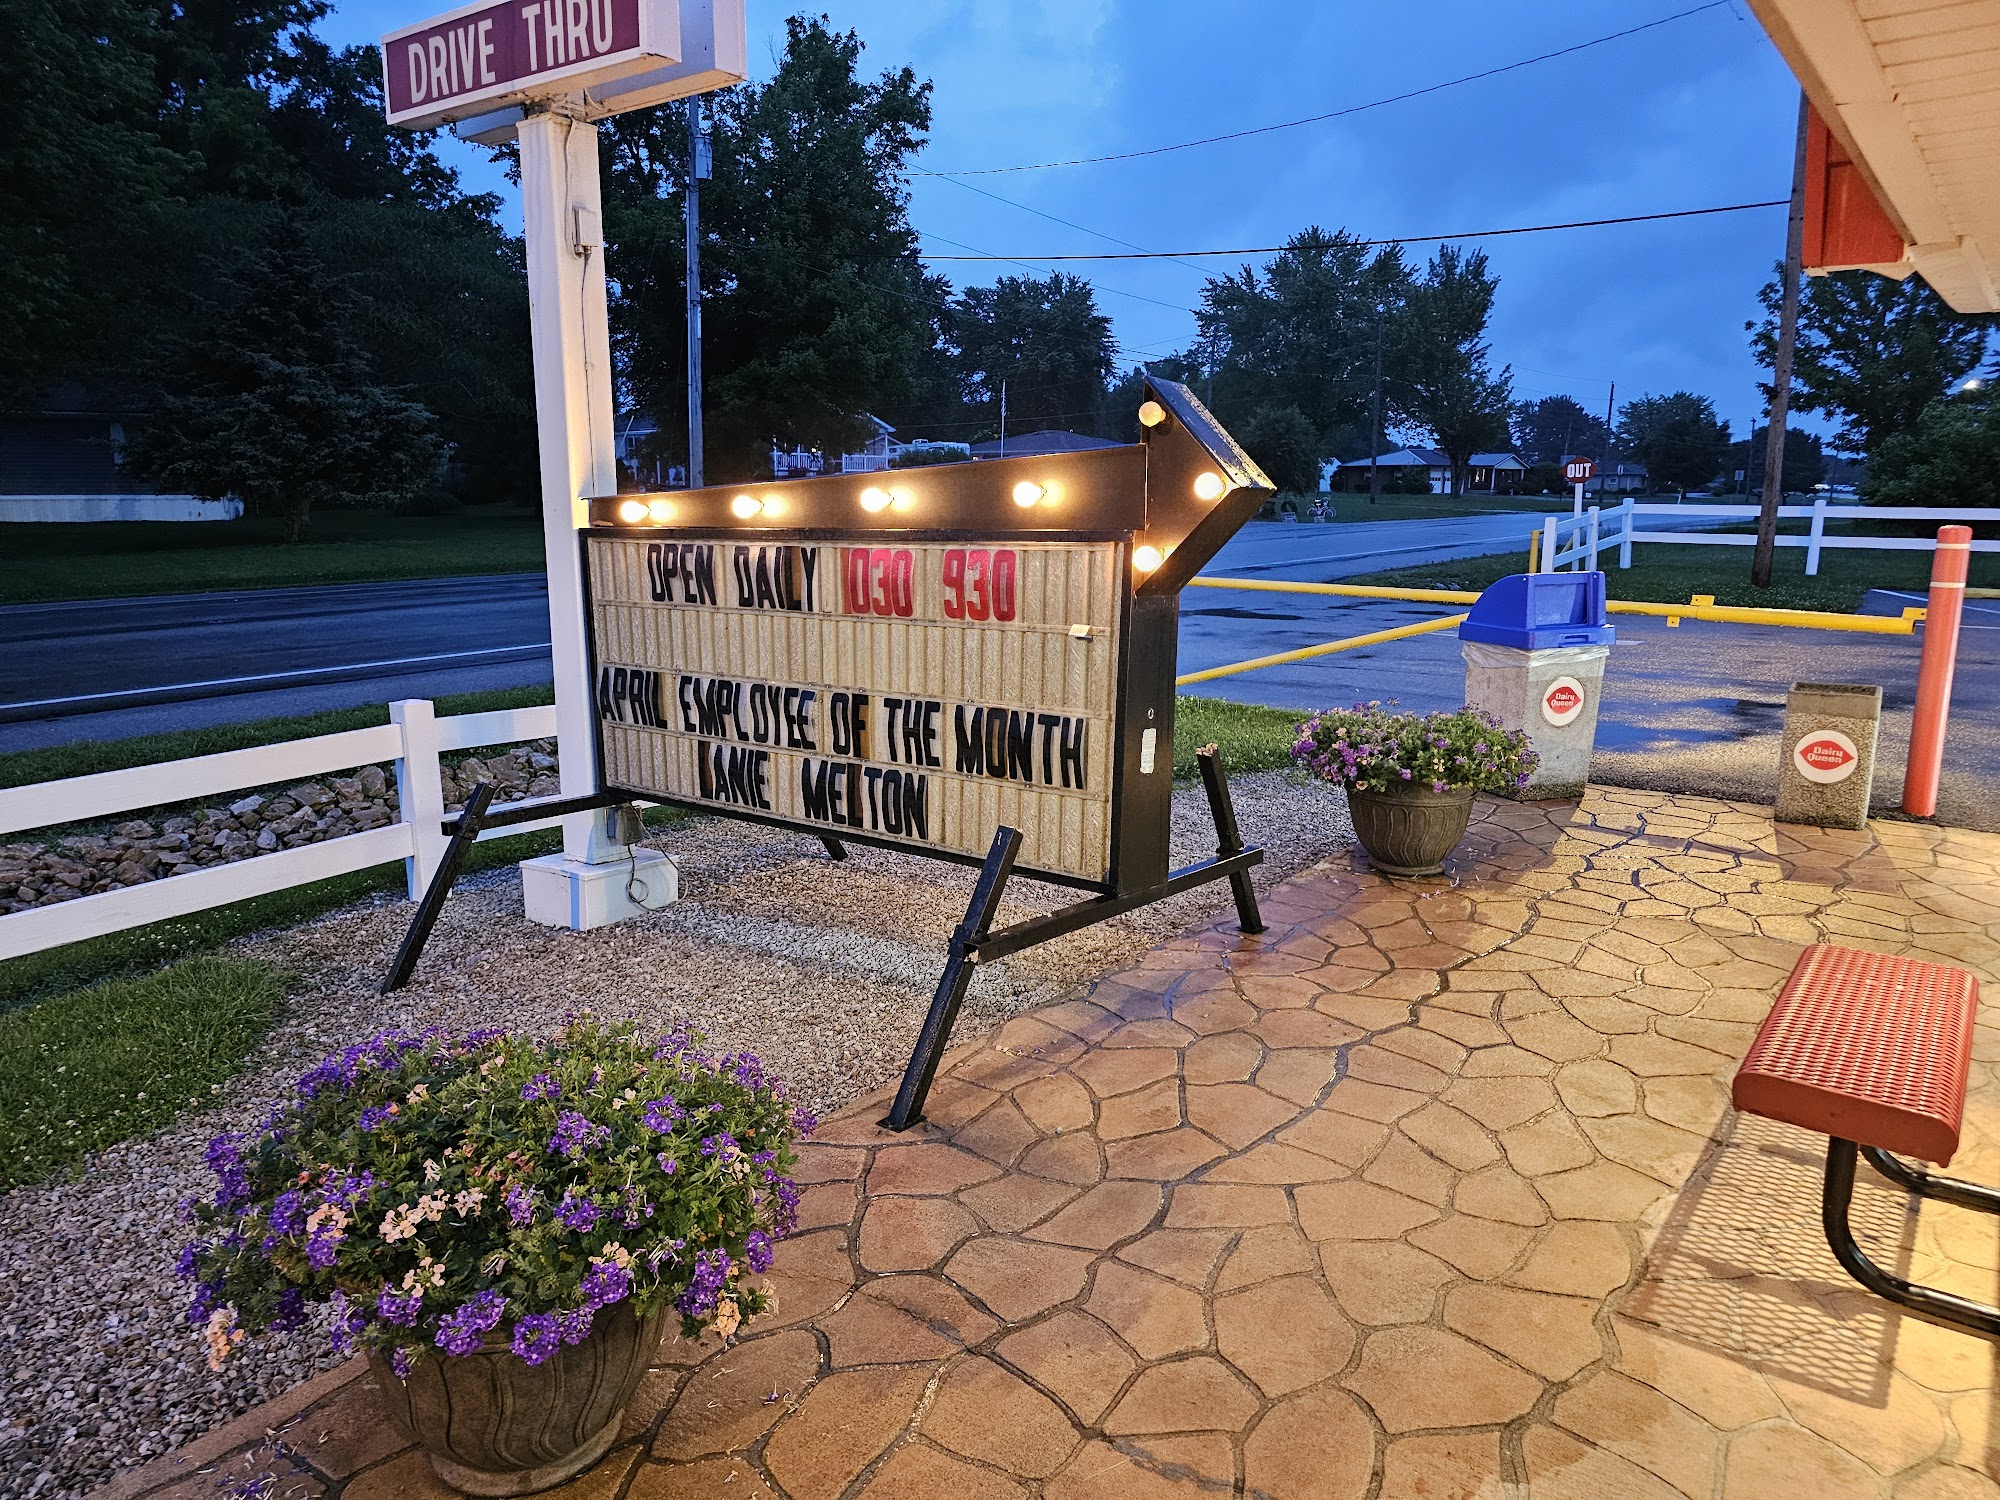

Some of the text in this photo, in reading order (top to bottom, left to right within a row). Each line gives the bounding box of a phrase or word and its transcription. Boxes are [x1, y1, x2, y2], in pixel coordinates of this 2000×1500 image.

[407, 0, 613, 104] DRIVE THRU
[1566, 462, 1592, 478] OUT
[648, 543, 717, 606] OPEN
[733, 545, 817, 612] DAILY
[943, 549, 1016, 622] 930
[1550, 699, 1574, 708] Queen
[1555, 692, 1575, 701] Dairy
[599, 667, 668, 729] APRIL
[678, 675, 817, 750] EMPLOYEE
[830, 692, 869, 758] OF
[884, 697, 941, 767] THE
[954, 704, 1084, 790] MONTH
[1806, 752, 1843, 764] Queen
[1813, 746, 1844, 758] Dairy
[801, 757, 926, 840] MELTON
